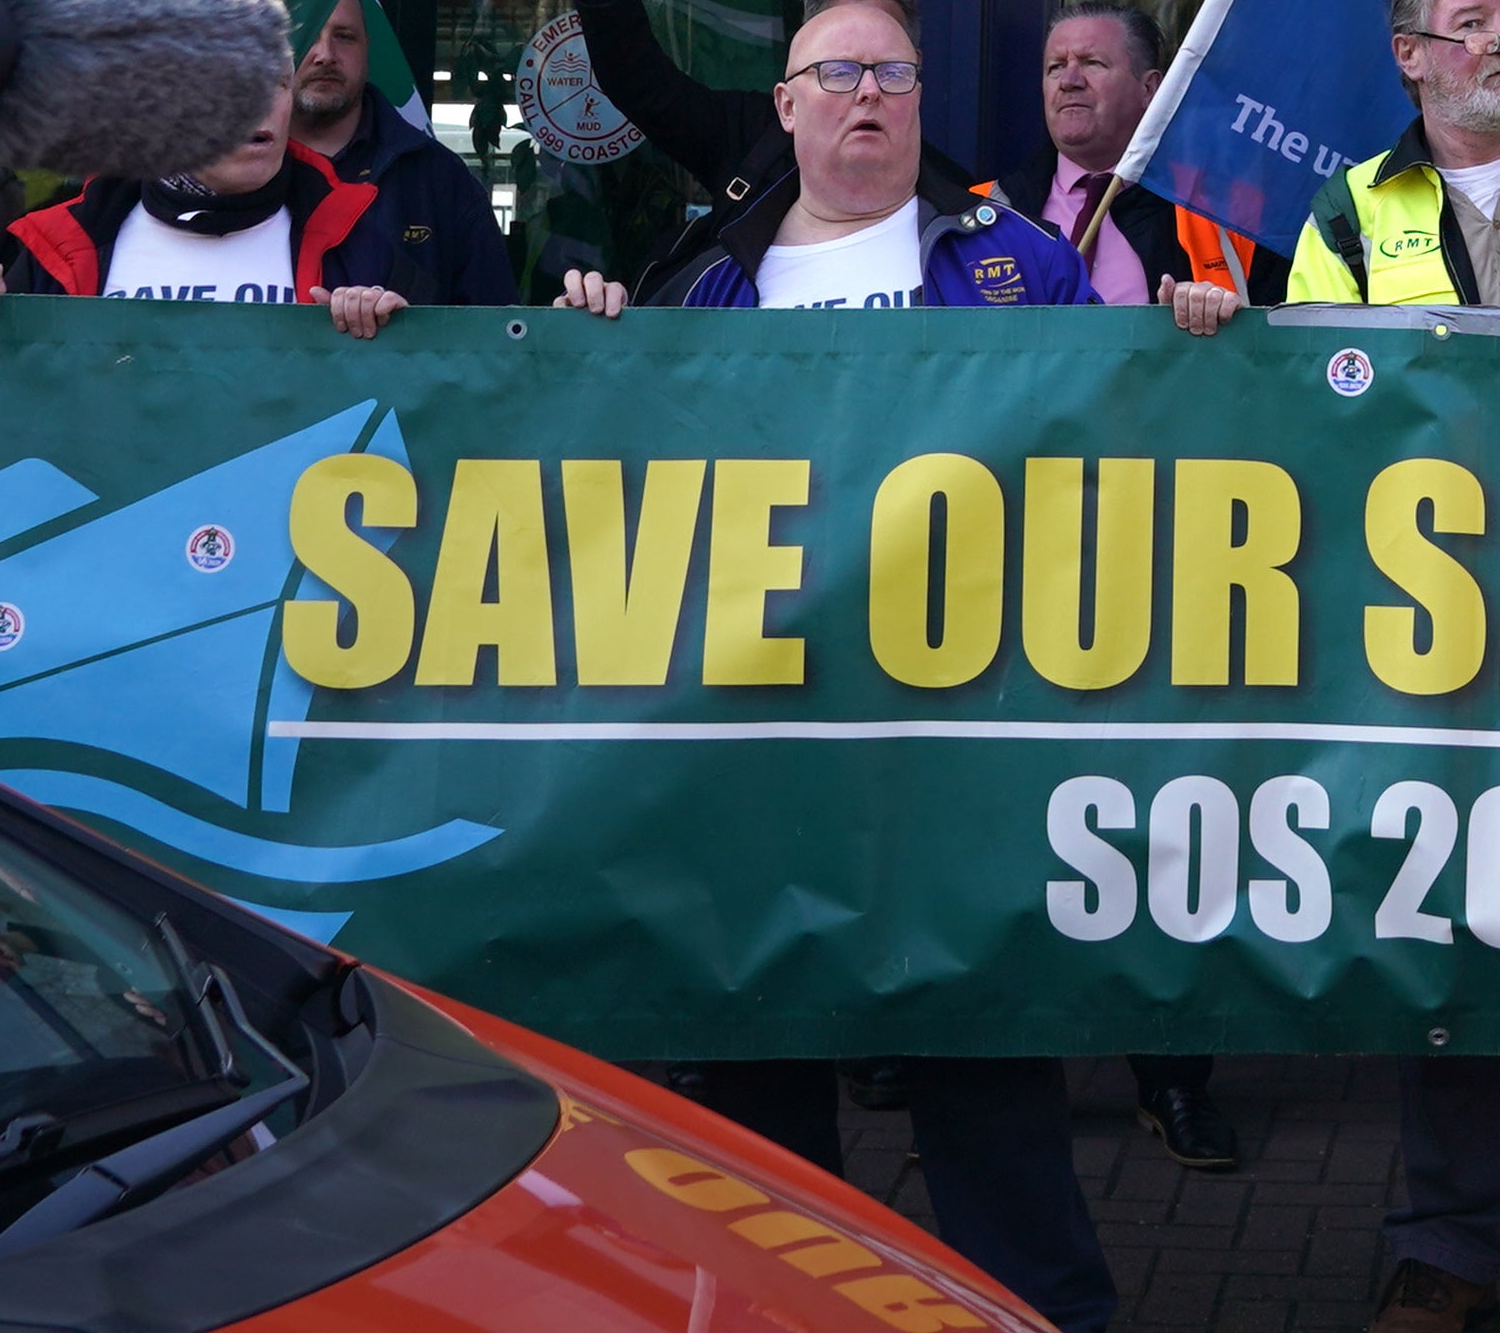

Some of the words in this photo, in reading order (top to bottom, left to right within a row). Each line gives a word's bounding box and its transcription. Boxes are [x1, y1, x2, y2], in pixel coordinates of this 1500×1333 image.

[532, 14, 583, 53] EMER
[547, 77, 583, 86] WATER
[519, 77, 538, 128] CALL
[536, 126, 564, 153] 999
[568, 127, 643, 160] COASTG
[576, 121, 601, 131] MUD
[1230, 93, 1310, 163] The
[1395, 237, 1433, 252] RMT
[975, 263, 1015, 279] RMT
[283, 453, 811, 690] SAVE
[868, 453, 1302, 692] OUR
[1046, 774, 1332, 944] SOS
